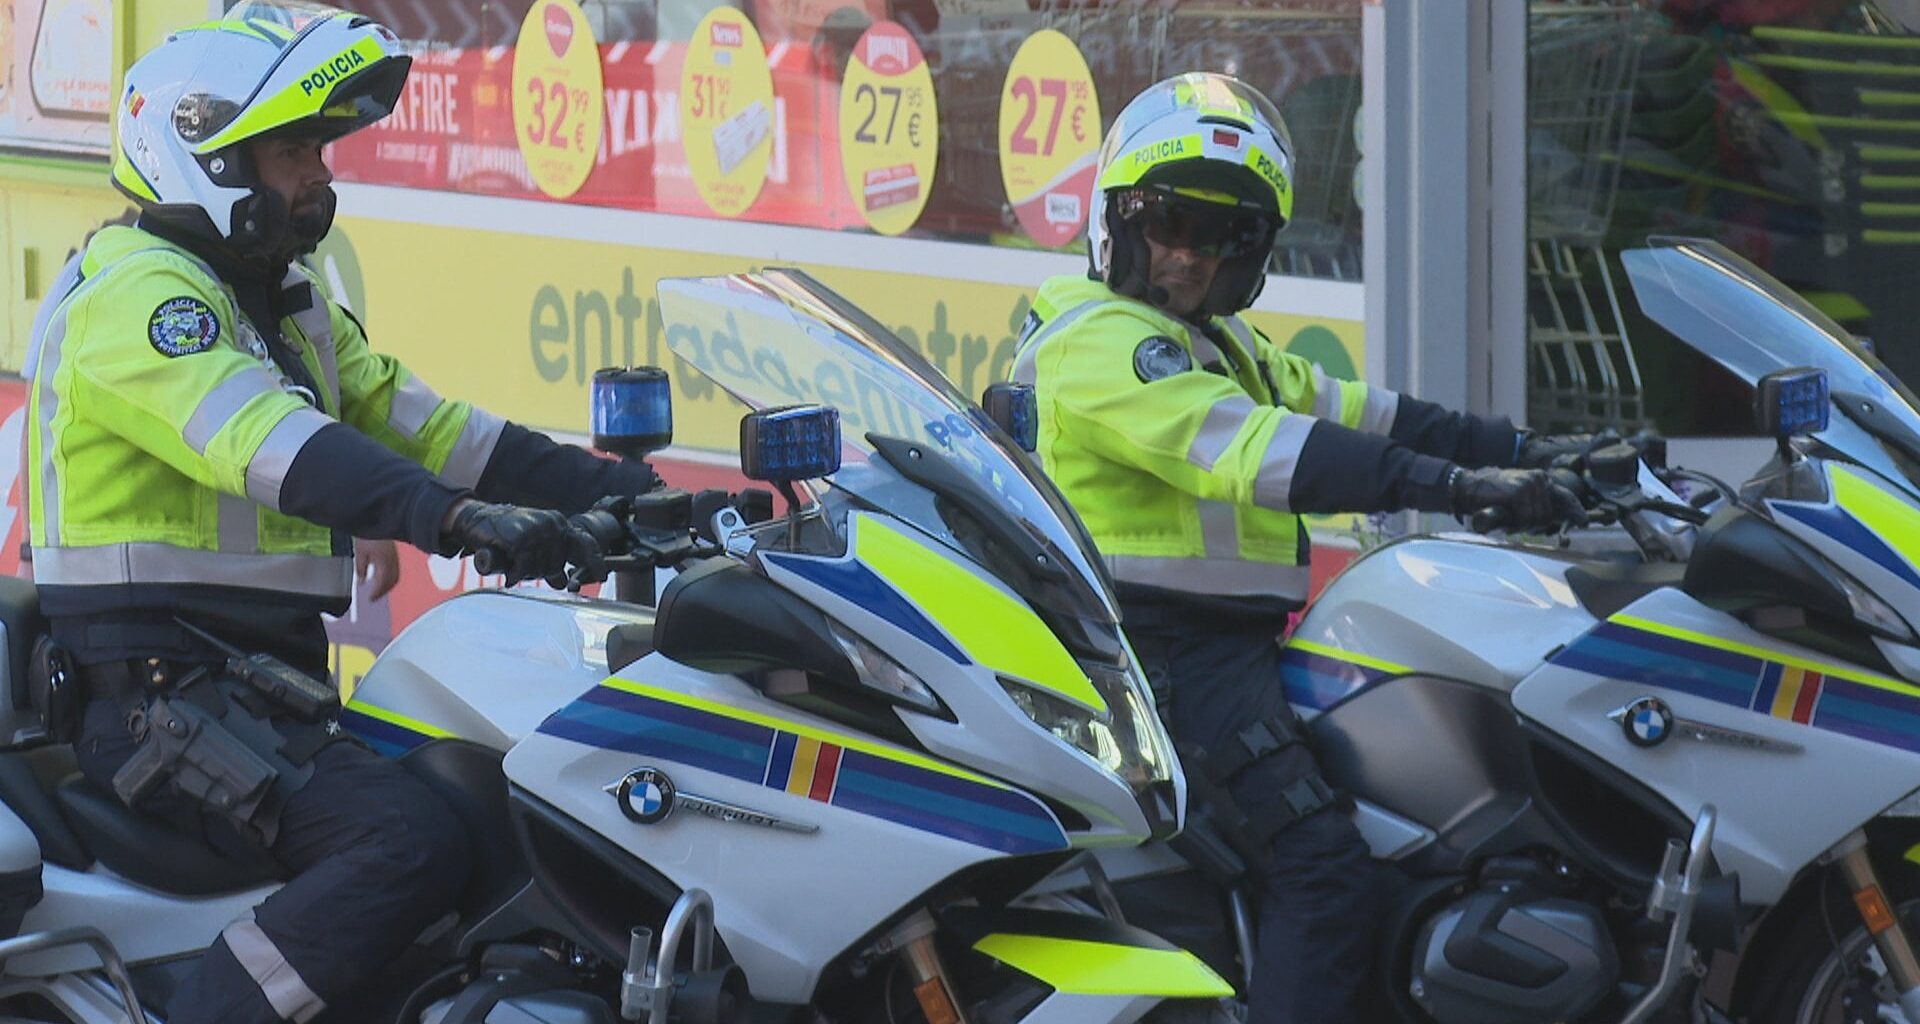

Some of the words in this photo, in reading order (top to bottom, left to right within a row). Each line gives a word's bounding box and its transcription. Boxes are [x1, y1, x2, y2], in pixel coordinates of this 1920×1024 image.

[301, 49, 364, 97] POLICIA
[408, 70, 460, 134] FIRE
[908, 113, 921, 148] €
[1072, 105, 1086, 143] €
[1134, 138, 1185, 164] POLICIA
[625, 772, 671, 794] BMW
